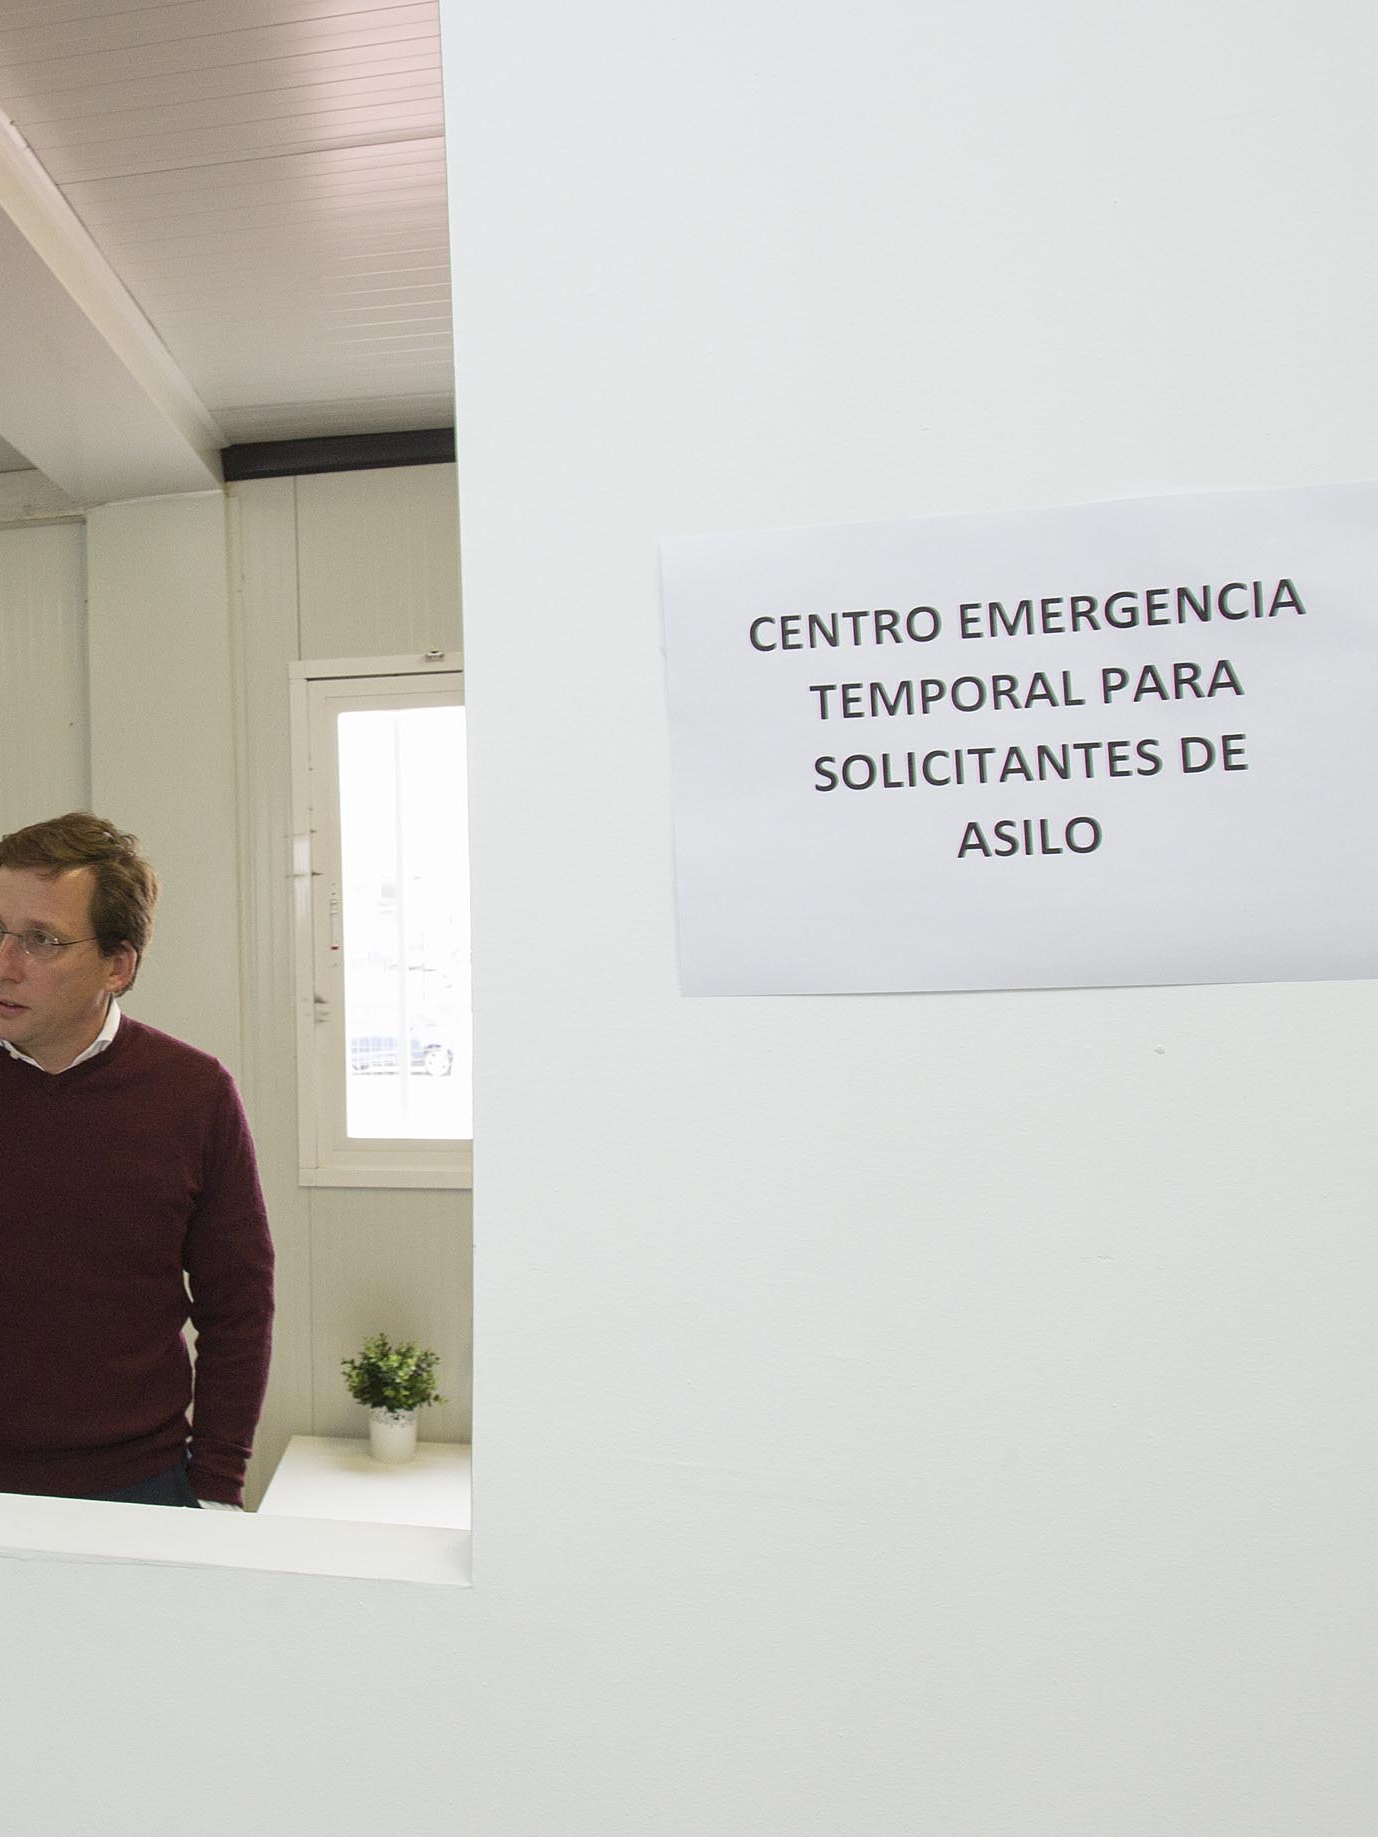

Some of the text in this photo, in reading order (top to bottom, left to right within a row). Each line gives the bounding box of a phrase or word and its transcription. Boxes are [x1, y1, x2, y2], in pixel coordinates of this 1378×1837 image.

[749, 577, 1306, 652] CENTRO EMERGENCIA
[809, 659, 1244, 720] TEMPORAL PARA
[814, 733, 1249, 792] SOLICITANTES DE
[958, 816, 1102, 859] ASILO
